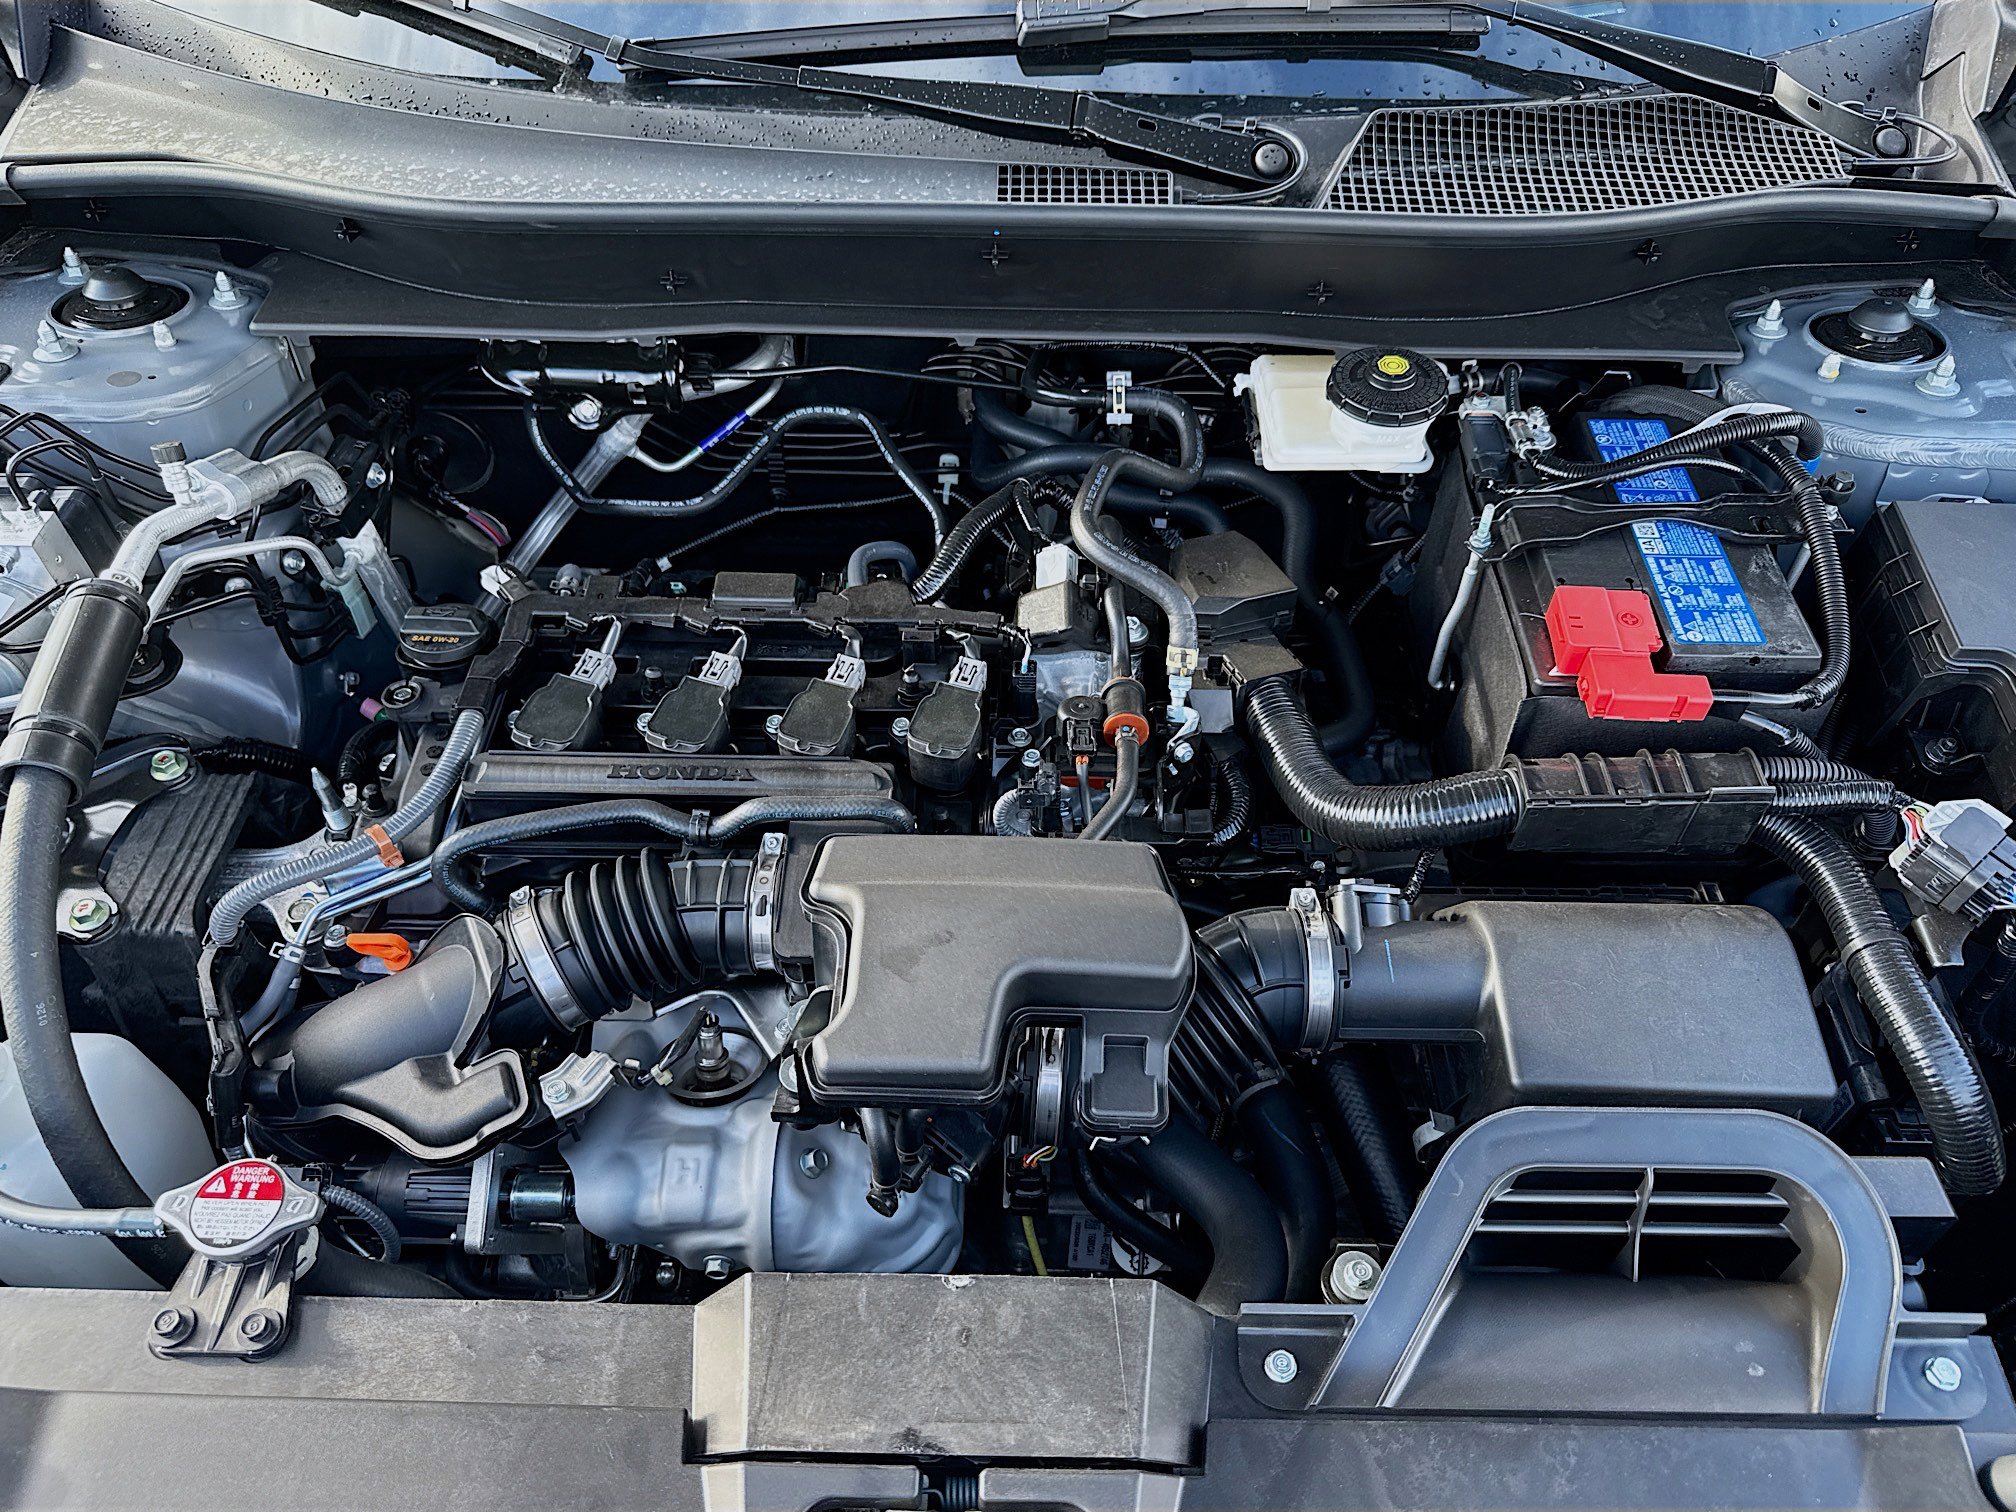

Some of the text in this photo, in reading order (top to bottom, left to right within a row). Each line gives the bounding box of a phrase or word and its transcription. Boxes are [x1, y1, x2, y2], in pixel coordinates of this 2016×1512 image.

[606, 763, 755, 782] HONDA
[232, 1166, 270, 1175] DANGER
[230, 1173, 275, 1183] WARNUNG
